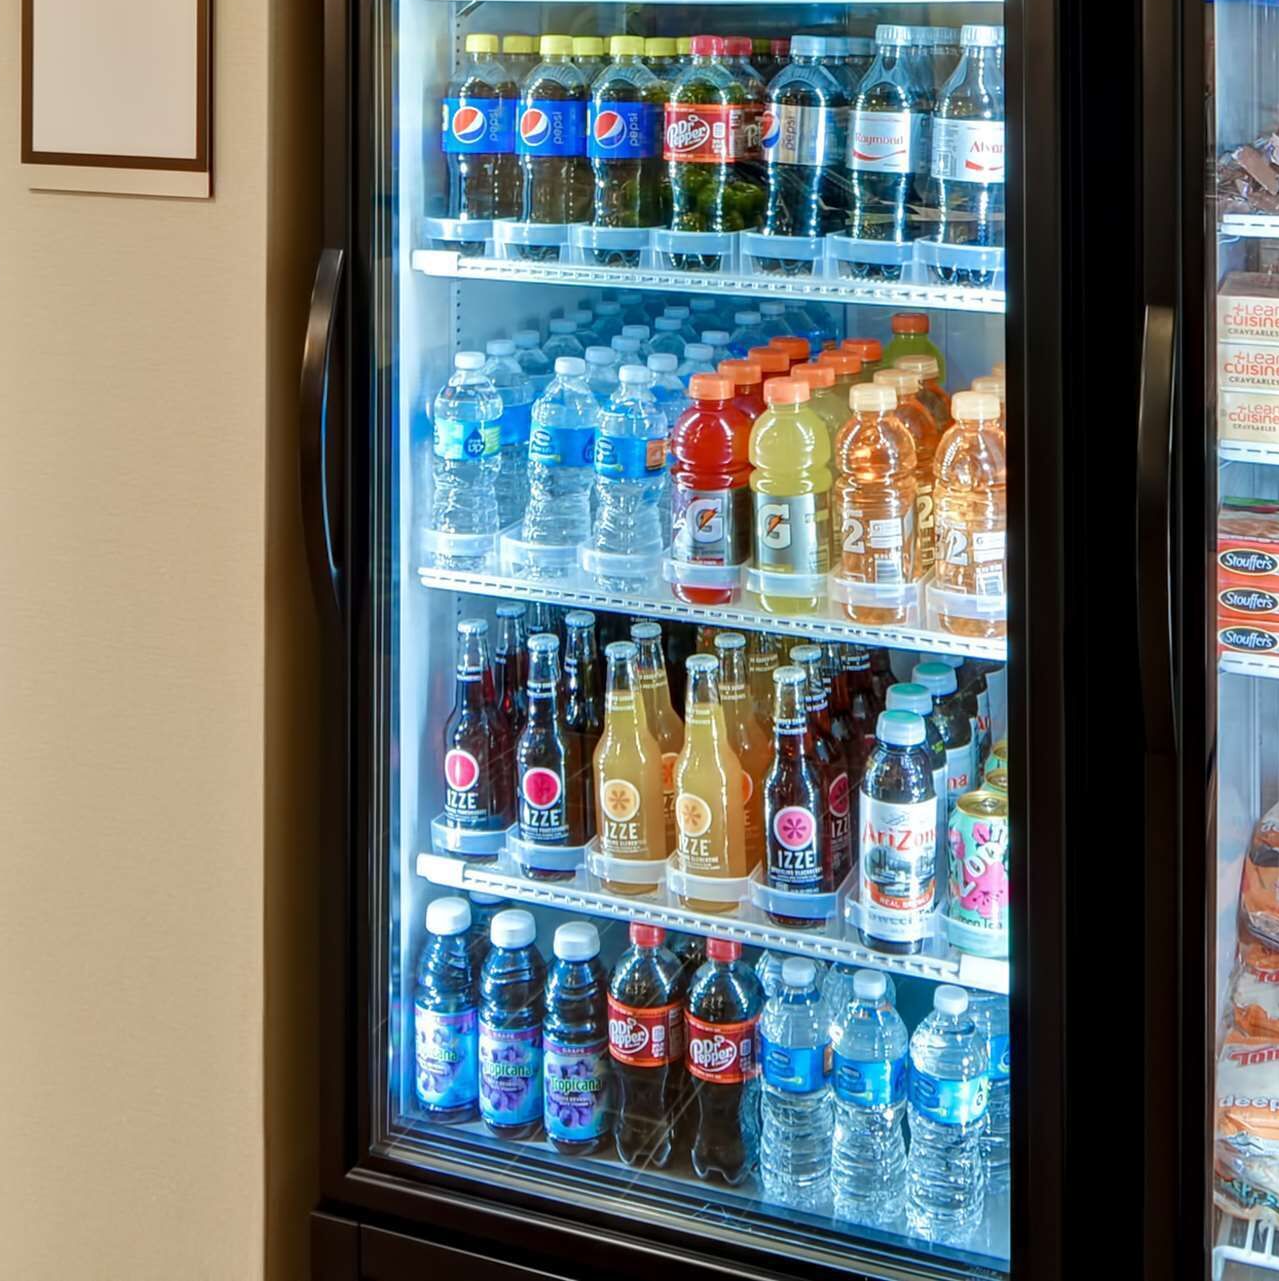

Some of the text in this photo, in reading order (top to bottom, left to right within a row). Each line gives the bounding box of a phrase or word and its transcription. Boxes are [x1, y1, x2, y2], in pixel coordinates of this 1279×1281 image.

[489, 109, 498, 142] pepsi
[553, 111, 563, 144] pepsi
[628, 112, 639, 147] pepsi
[667, 123, 707, 148] Pepper
[677, 120, 694, 134] Dr
[786, 115, 797, 151] pepsi
[693, 498, 723, 543] G
[760, 503, 792, 550] G
[1224, 552, 1274, 572] Stouffer's
[1224, 591, 1275, 610] Stouffer's
[1224, 629, 1274, 649] Stouffer's
[446, 789, 479, 810] IZZE
[604, 821, 639, 840] IZZE
[777, 850, 815, 869] IZZE
[608, 1019, 646, 1048] Pepper
[617, 1020, 633, 1033] Dr
[690, 1039, 733, 1067] Pepper
[703, 1039, 721, 1053] Dr
[551, 1075, 602, 1093] Tropicana
